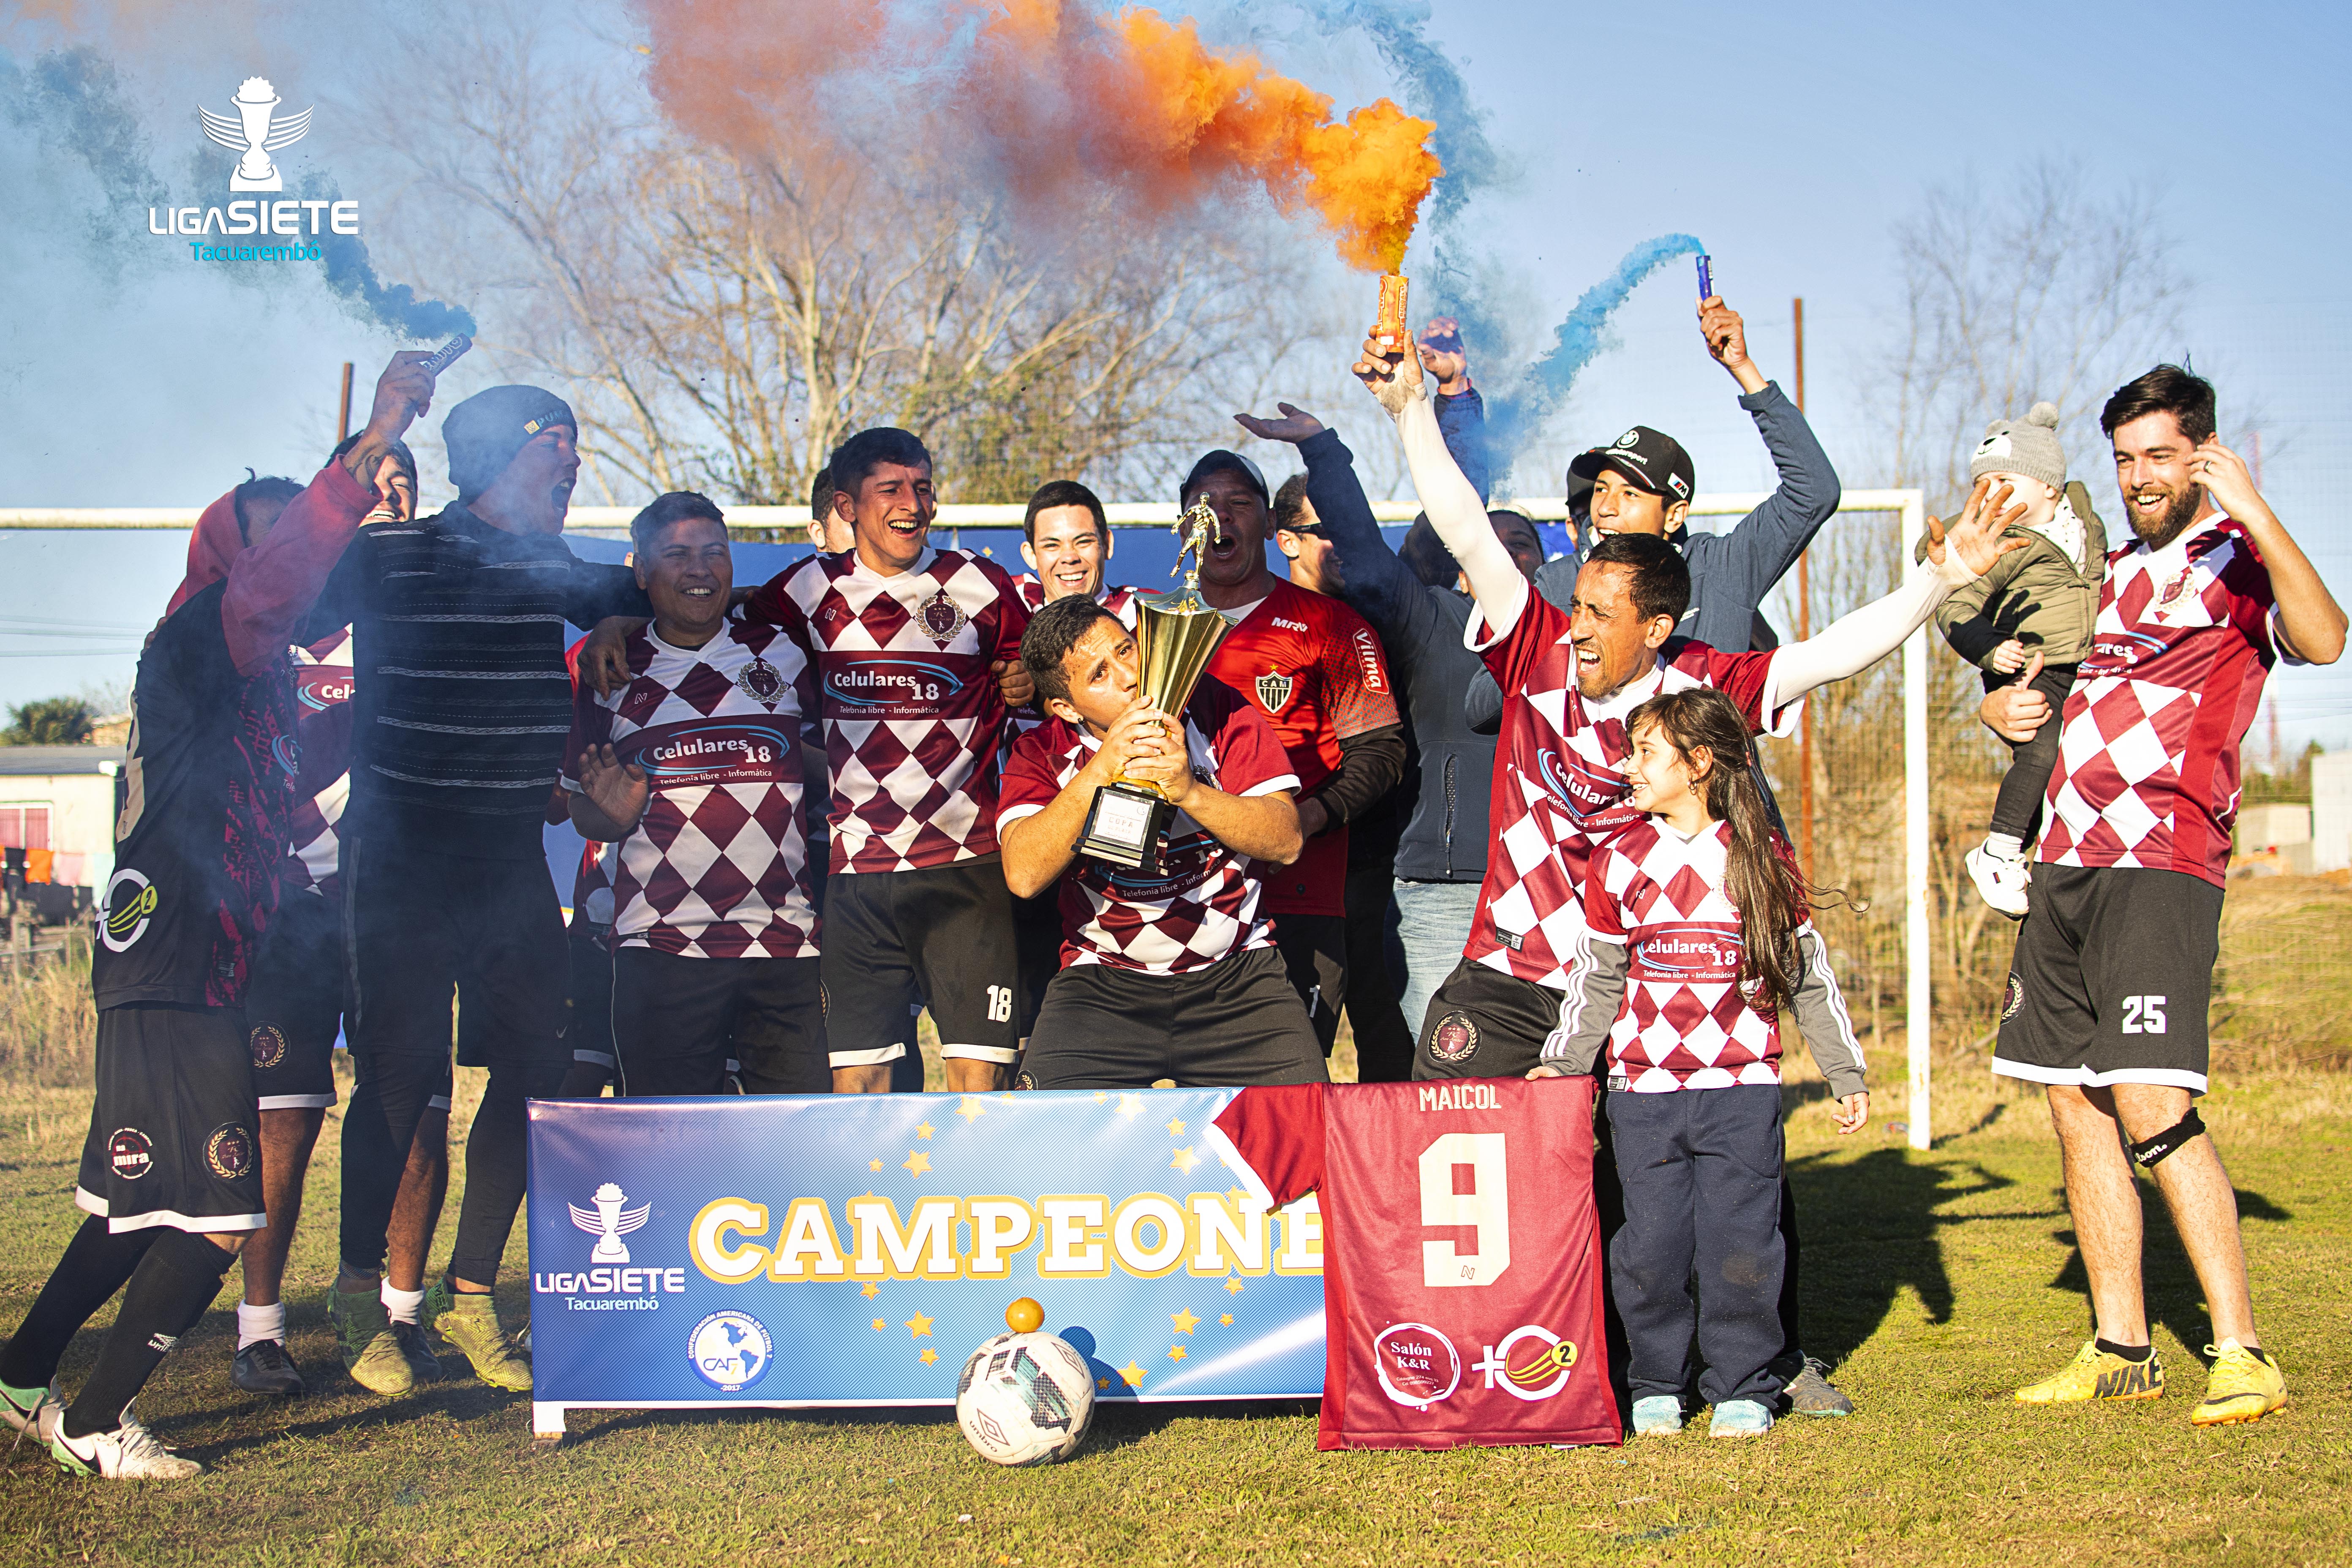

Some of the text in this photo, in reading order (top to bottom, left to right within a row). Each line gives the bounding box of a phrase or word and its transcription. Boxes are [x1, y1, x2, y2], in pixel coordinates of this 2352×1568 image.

[1271, 617, 1308, 632] MRV
[1356, 632, 1382, 688] Vilma
[835, 671, 916, 687] Celulares
[912, 683, 939, 700] 18
[894, 706, 939, 714] Informática
[653, 738, 748, 760] Celulares
[744, 746, 771, 763] 18
[728, 769, 772, 777] Informática
[1109, 817, 1133, 828] COPA
[1573, 816, 1589, 828] libre
[1160, 883, 1179, 893] libre
[1644, 939, 1717, 954] elulares
[1712, 950, 1737, 966] 18
[987, 985, 1012, 1022] 18
[2122, 995, 2167, 1034] 25
[1419, 1084, 1502, 1111] MAICOL
[113, 1153, 150, 1166] mira
[1418, 1133, 1511, 1288] 9
[692, 1197, 1324, 1281] CAMPEONE
[536, 1267, 685, 1293] LIGASIETE
[565, 1295, 659, 1310] Tacuarembó
[688, 1313, 716, 1359] CONFEDERACIÓN
[716, 1310, 755, 1323] AMERICANA
[754, 1320, 764, 1330] DE
[761, 1328, 773, 1353] FÚTBOL
[1390, 1341, 1433, 1356] Salón
[1396, 1356, 1431, 1370] K&R
[2094, 1361, 2162, 1398] NIKE
[969, 1420, 997, 1453] umbro
